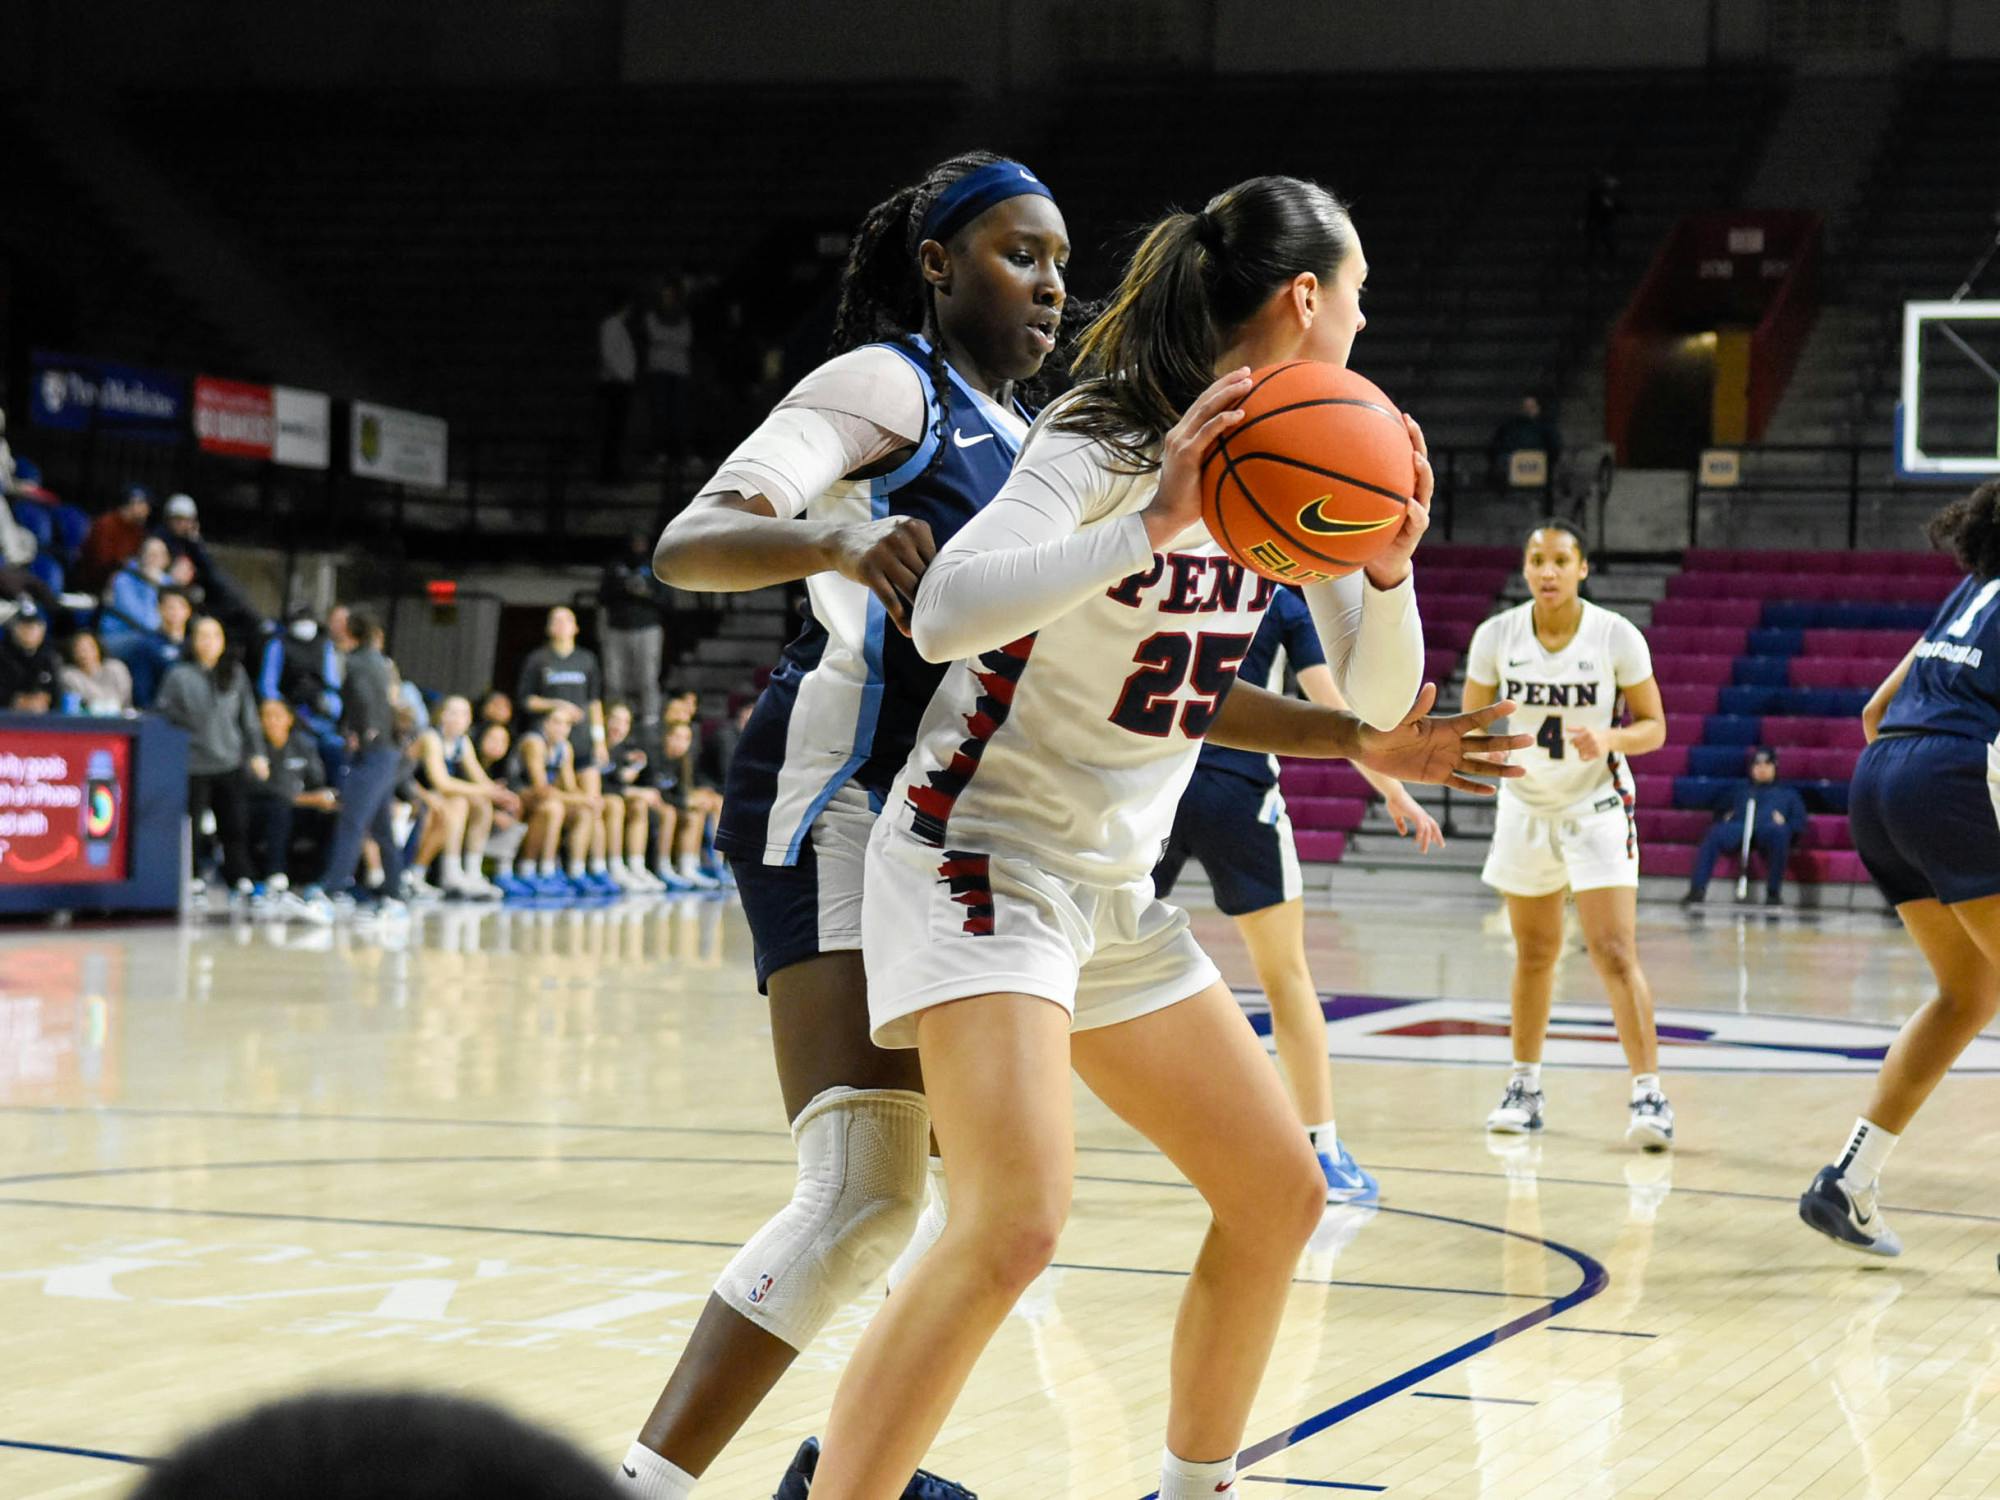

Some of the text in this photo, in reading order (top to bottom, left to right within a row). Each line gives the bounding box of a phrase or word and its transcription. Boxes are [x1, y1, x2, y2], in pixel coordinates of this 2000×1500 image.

[1248, 540, 1338, 583] ELIT
[1946, 578, 2000, 638] 1
[1108, 631, 1253, 739] 25
[1505, 679, 1600, 707] PENN
[1536, 714, 1565, 760] 4
